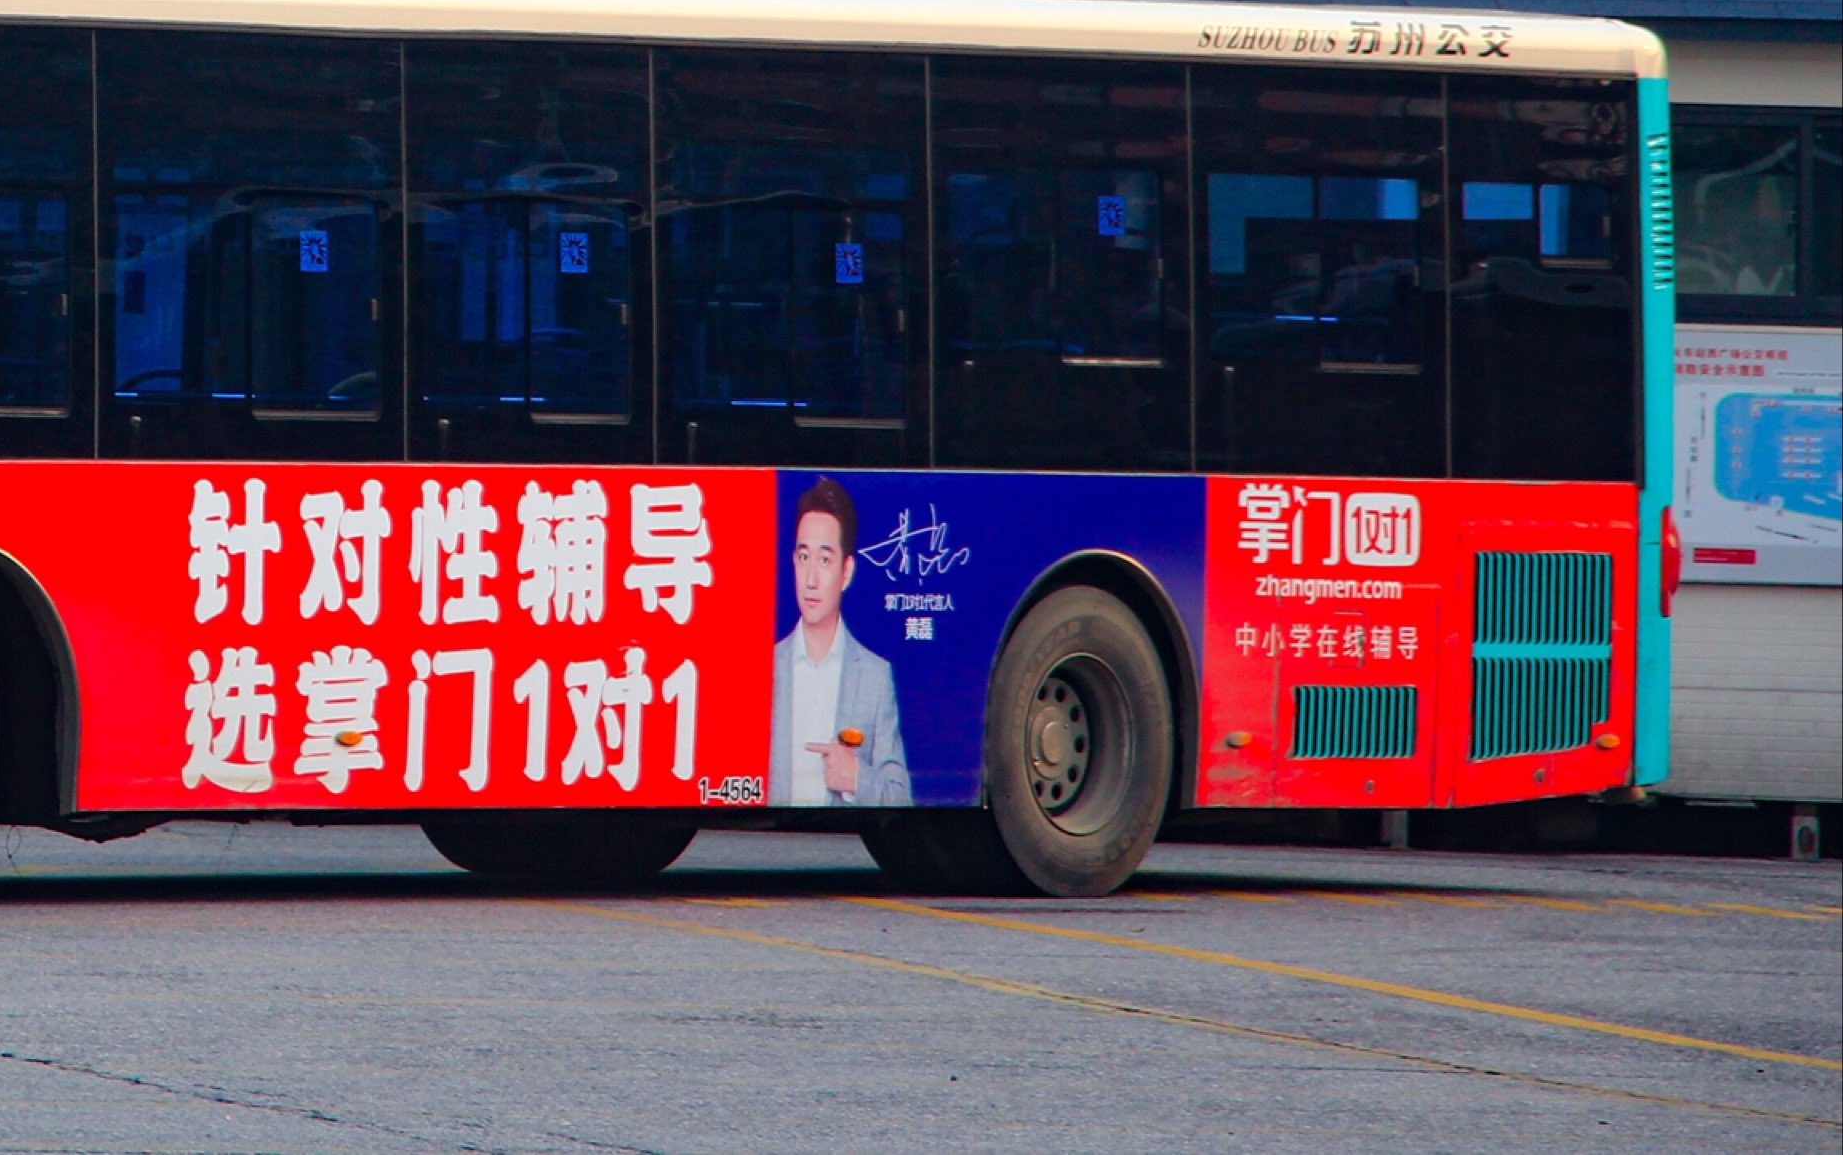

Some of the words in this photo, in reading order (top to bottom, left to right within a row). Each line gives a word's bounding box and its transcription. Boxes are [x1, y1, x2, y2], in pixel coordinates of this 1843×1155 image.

[1198, 24, 1292, 52] SUZHOU
[1292, 28, 1339, 54] BUS
[1346, 20, 1513, 58] 苏州公交
[188, 478, 713, 626] 针对性辅导
[1256, 574, 1402, 605] zhangmen.com
[1235, 622, 1418, 660] 中小学在线辅导
[181, 645, 698, 794] 选掌门1对1
[699, 777, 763, 803] 1-4564
